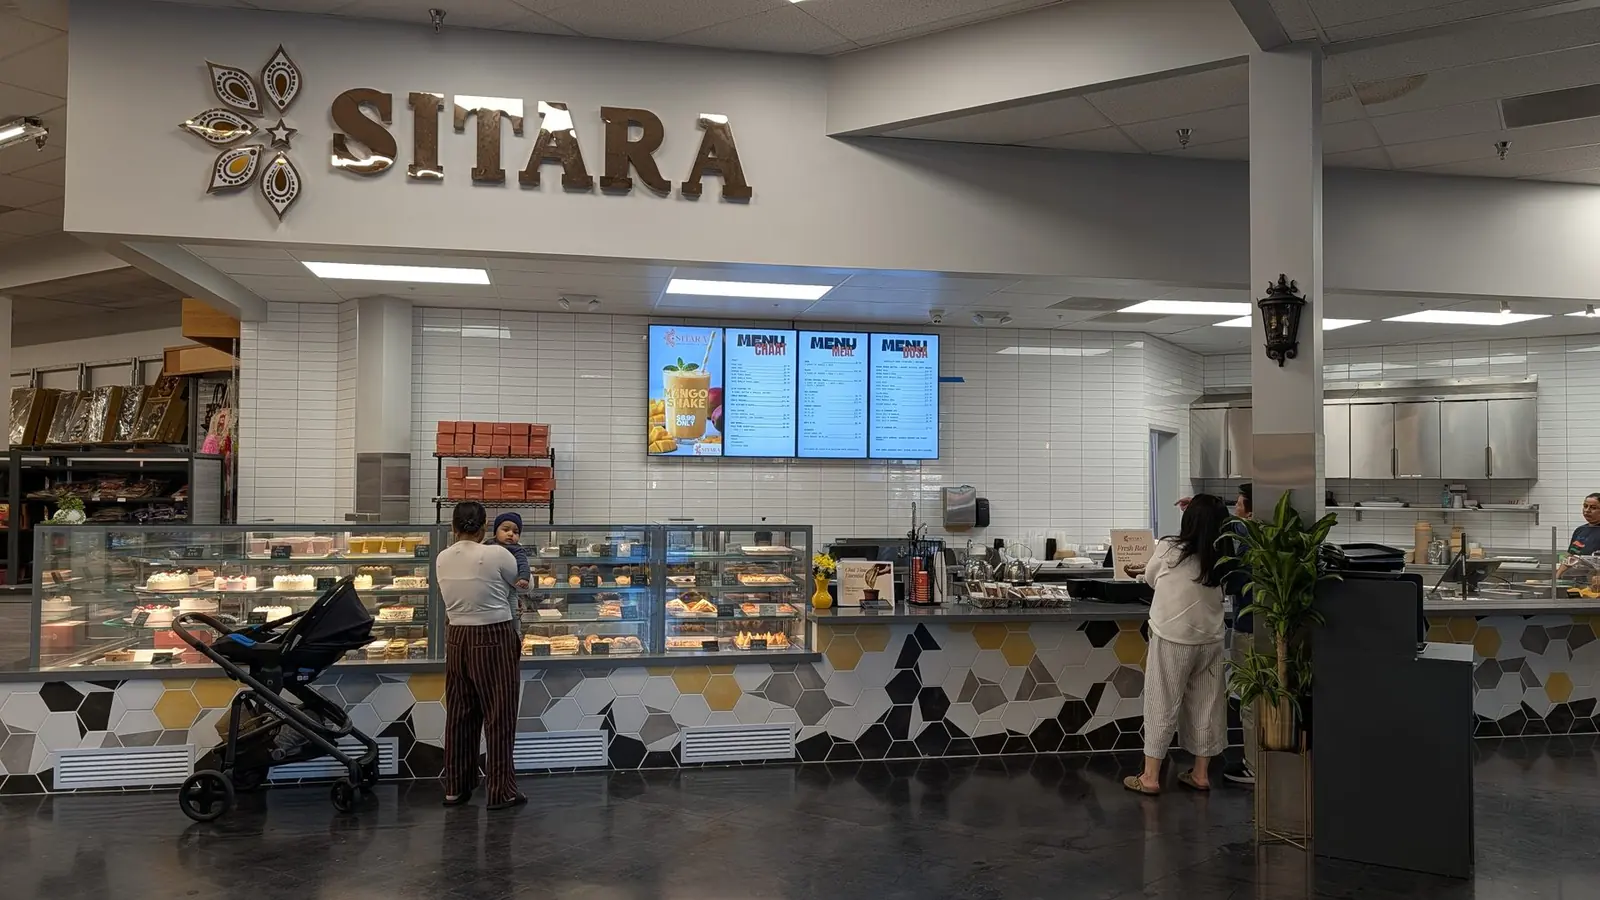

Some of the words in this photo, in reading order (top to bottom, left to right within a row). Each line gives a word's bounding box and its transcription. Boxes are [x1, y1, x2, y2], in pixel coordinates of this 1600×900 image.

[331, 87, 753, 204] SITARA
[737, 334, 786, 347] MENU
[810, 336, 857, 350] MENU
[881, 339, 928, 352] MENU
[755, 343, 786, 356] CHAAT
[832, 346, 855, 357] MEAL
[903, 346, 928, 358] DOSA
[664, 388, 709, 399] MANGO
[667, 399, 706, 409] SHAKE
